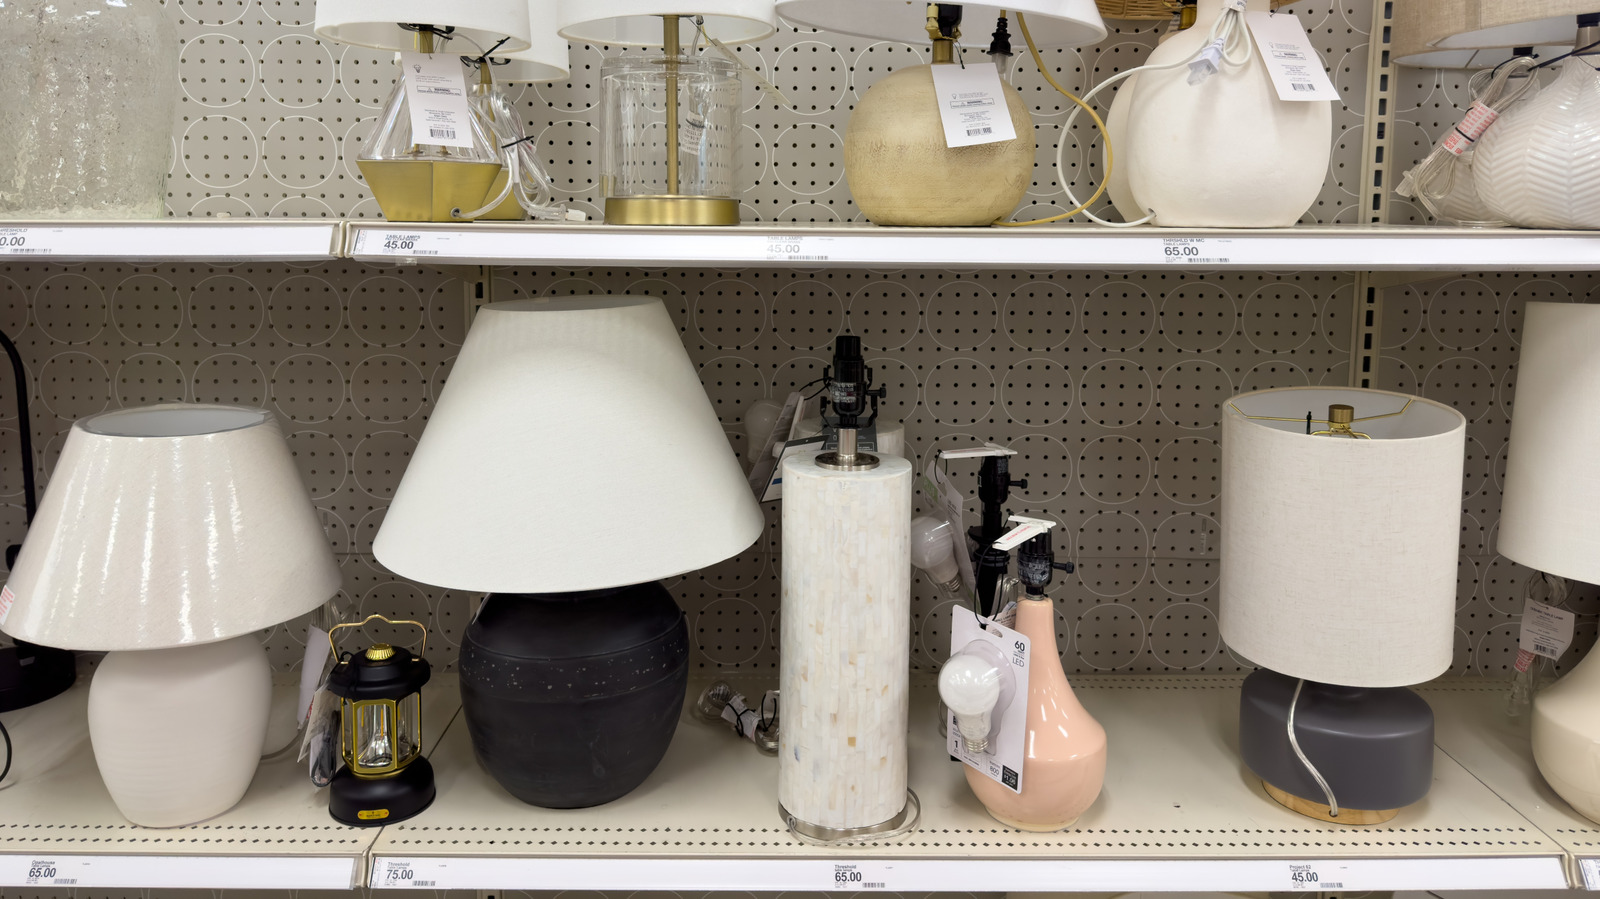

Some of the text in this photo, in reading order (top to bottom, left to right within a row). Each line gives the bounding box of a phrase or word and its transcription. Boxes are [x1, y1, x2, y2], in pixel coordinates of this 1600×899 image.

[384, 240, 413, 249] 45.00
[767, 244, 800, 253] 45.00
[1164, 246, 1198, 256] 65.00
[1014, 640, 1025, 651] 60
[1012, 657, 1024, 667] LED
[954, 740, 958, 748] 1
[989, 765, 999, 775] 800
[28, 867, 56, 878] 65.00
[386, 869, 414, 880] 75.00
[835, 871, 862, 882] 65.00
[1291, 871, 1318, 882] 45.00
